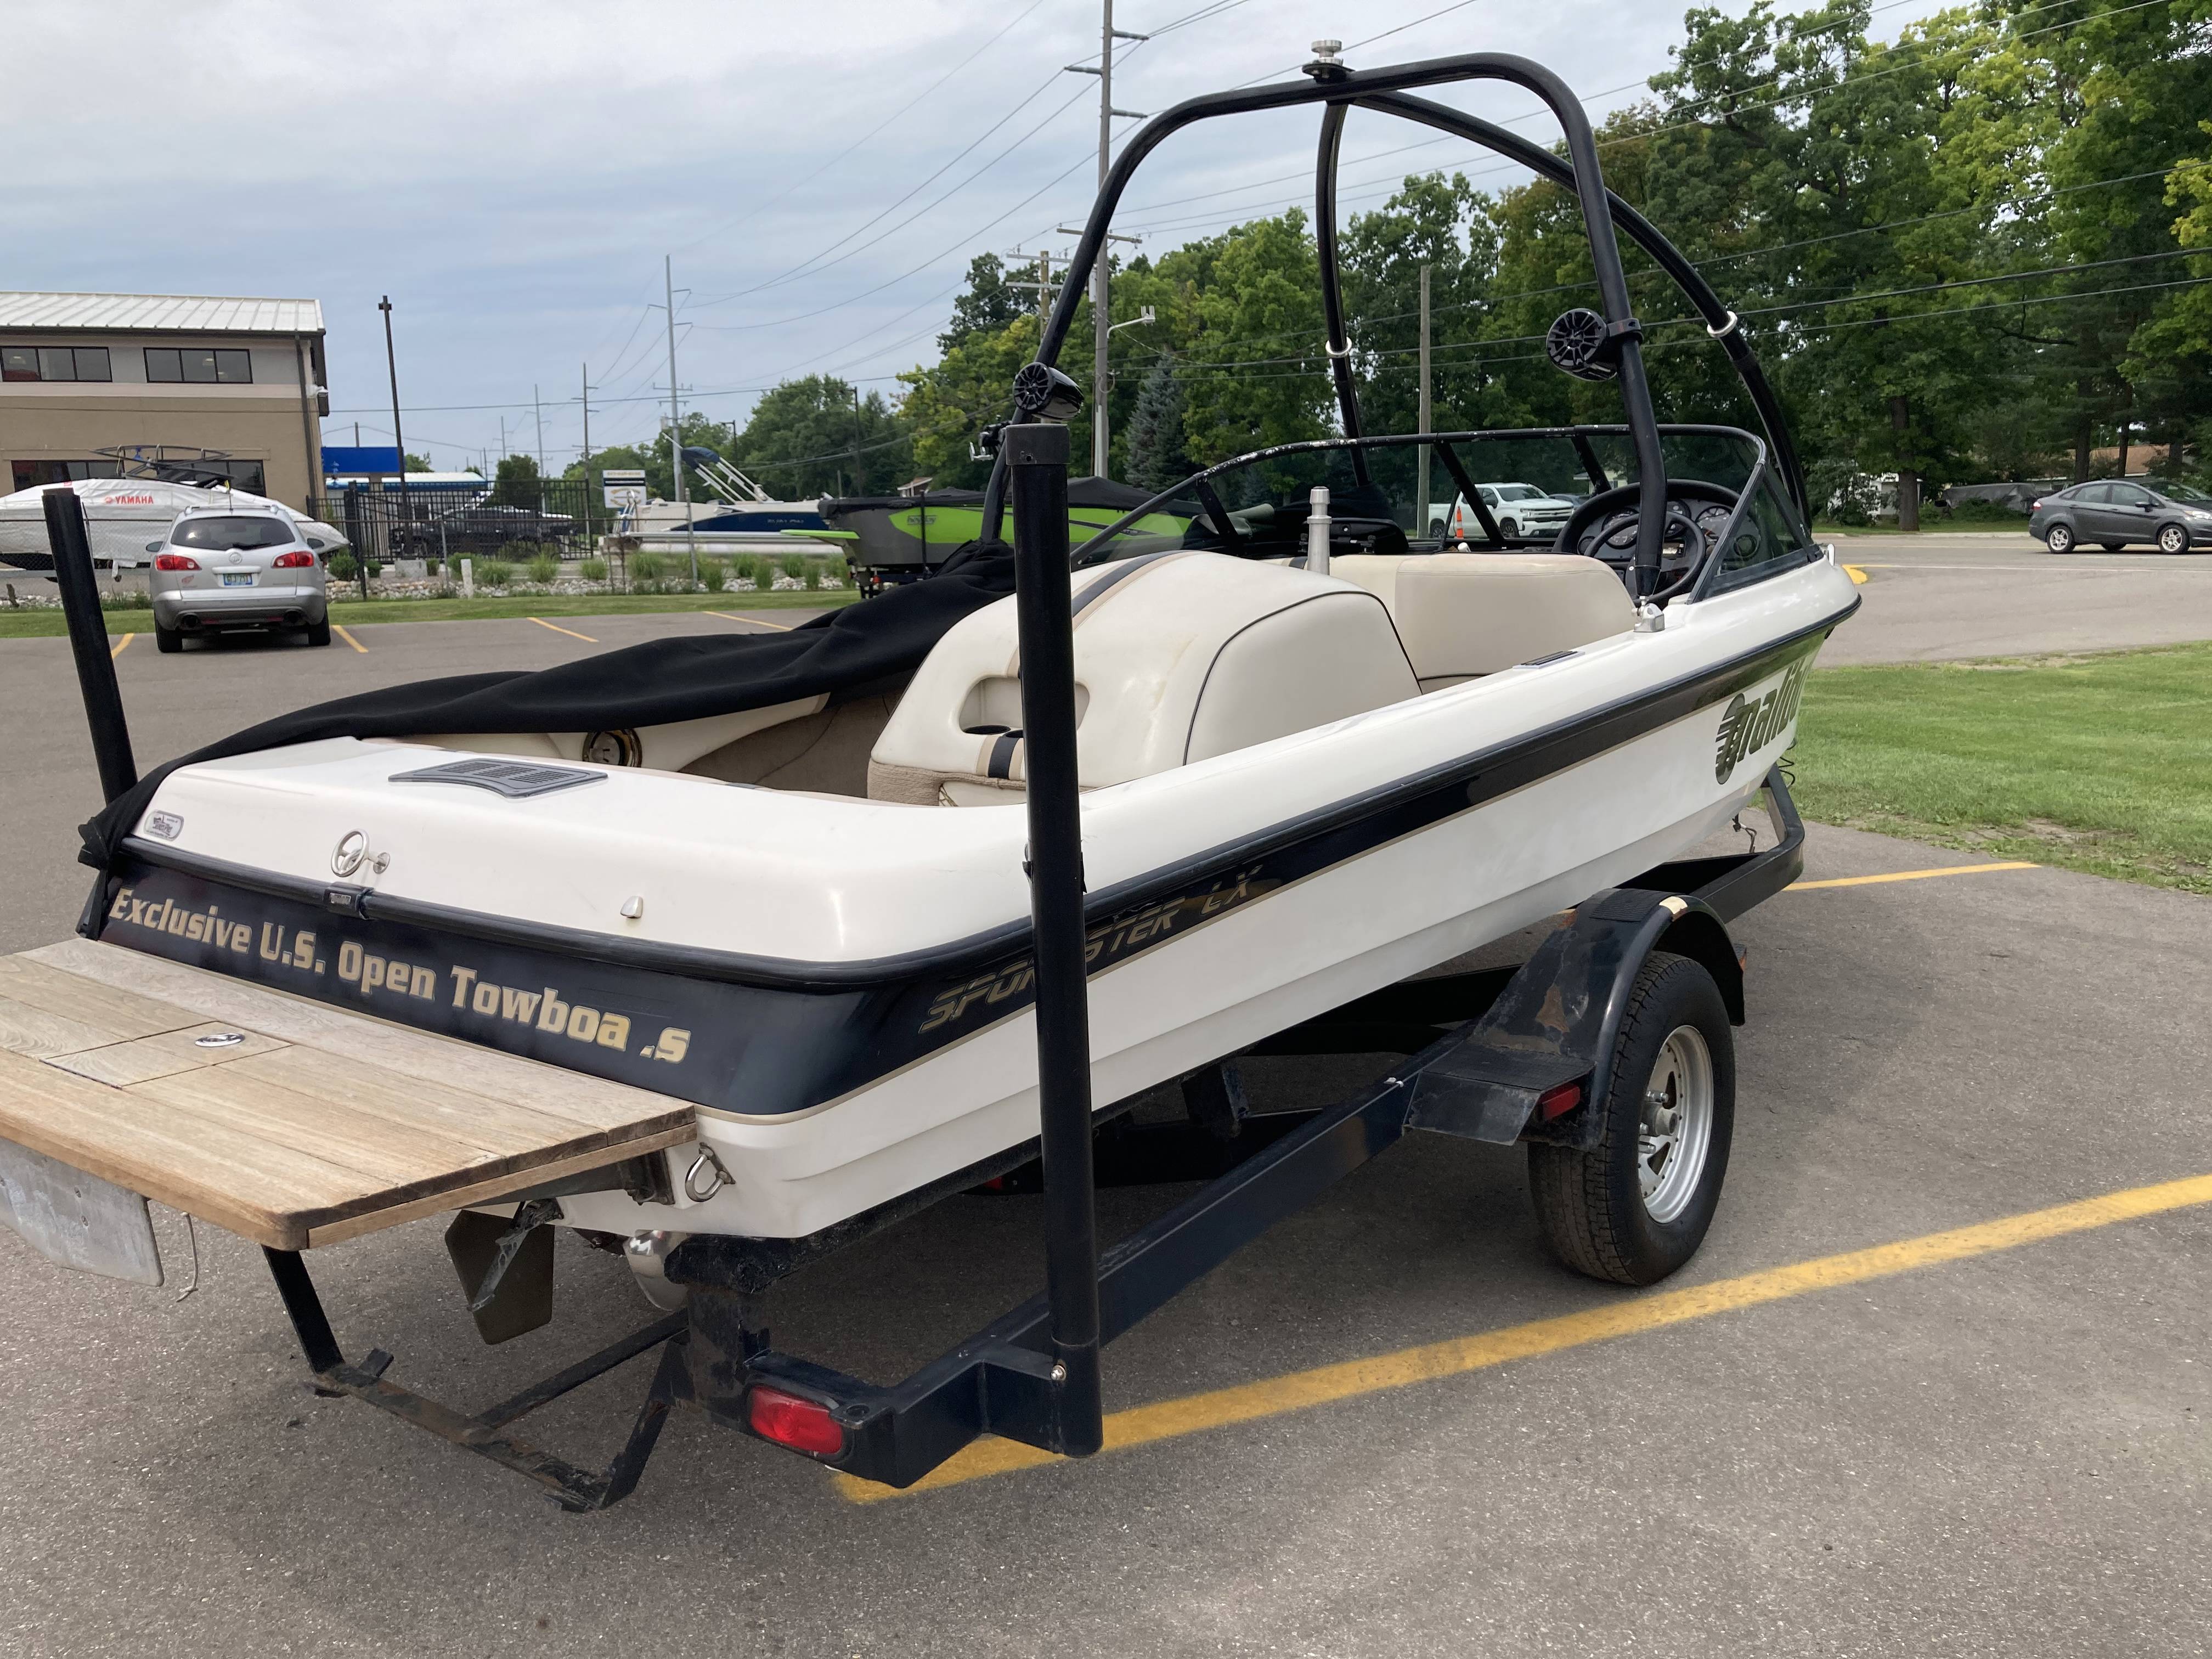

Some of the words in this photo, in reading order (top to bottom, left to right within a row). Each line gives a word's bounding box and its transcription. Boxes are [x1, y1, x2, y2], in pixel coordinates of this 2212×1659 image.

[115, 495, 154, 504] YAMAHA
[109, 887, 252, 953] Exclusive
[260, 922, 325, 974] U.S.
[338, 940, 437, 1001] Open
[918, 896, 1186, 1034] SPOSTER
[1200, 865, 1263, 916] LX
